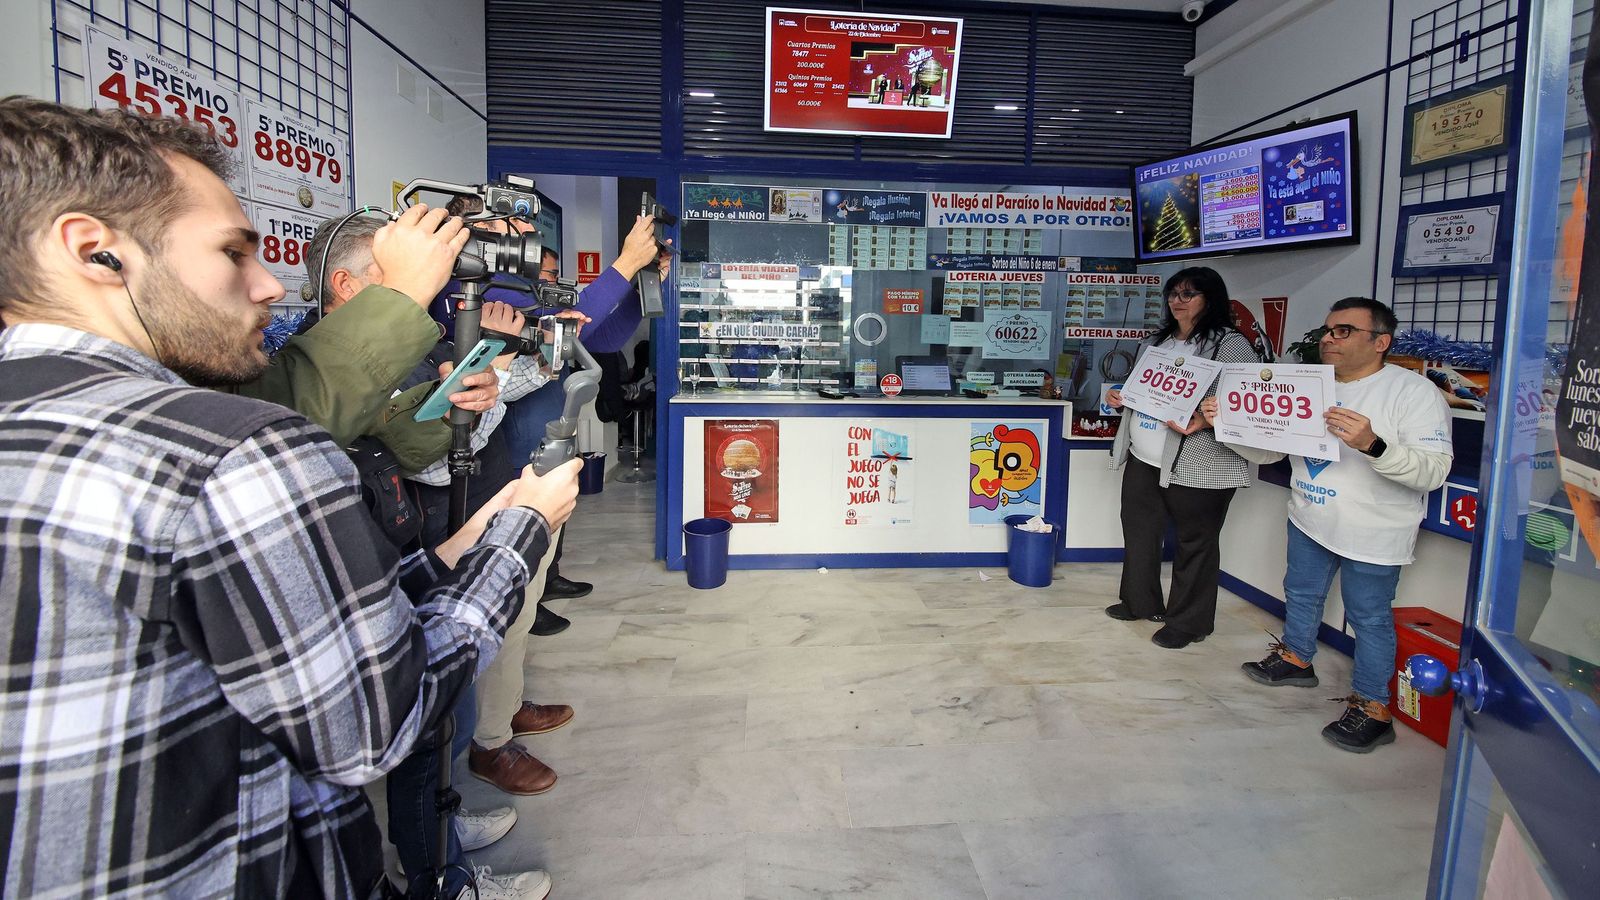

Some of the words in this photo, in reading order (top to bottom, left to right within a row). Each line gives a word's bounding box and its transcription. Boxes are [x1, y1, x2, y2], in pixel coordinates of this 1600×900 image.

[787, 40, 811, 48] Cuartos
[146, 53, 178, 72] VENDIDO
[180, 68, 197, 81] AQUÍ
[788, 73, 810, 81] Quintos
[810, 74, 833, 82] Premios
[134, 58, 229, 114] PREMIO
[99, 72, 239, 148] 45353
[1443, 100, 1472, 112] DIPLOMA
[1431, 109, 1483, 131] 19570
[1434, 126, 1462, 136] VENDIDO
[1463, 120, 1479, 129] AQUÍ
[275, 121, 335, 157] PREMIO
[254, 131, 341, 184] 88979
[1140, 163, 1180, 182] ¡FELIZ
[1184, 146, 1253, 170] NAVIDAD!
[1268, 184, 1278, 199] Ya
[1278, 183, 1294, 199] está
[1295, 175, 1311, 196] aquí
[1312, 172, 1320, 188] el
[1320, 168, 1341, 186] NIÑO
[862, 195, 886, 209] ¡Regala
[887, 193, 911, 205] ilusión!
[931, 193, 949, 209] Ya
[951, 193, 979, 212] llegó
[981, 196, 993, 210] al
[996, 195, 1040, 211] Paraíso
[1043, 196, 1054, 210] la
[1056, 196, 1107, 213] Navidad
[1109, 198, 1131, 213] 202
[685, 209, 700, 219] ¡Ya
[702, 209, 725, 221] llegó
[727, 210, 736, 219] el
[738, 209, 765, 220] NIÑO!
[869, 210, 894, 222] ¡Regala
[895, 208, 921, 221] lotería!
[939, 212, 1010, 226] ¡VAMOS
[1015, 214, 1028, 224] A
[1033, 214, 1070, 225] POR
[1075, 215, 1130, 227] OTRO!
[1436, 214, 1464, 222] DIPLOMA
[268, 218, 281, 235] 1er
[282, 221, 317, 240] PRE
[1423, 225, 1475, 238] 05490
[992, 256, 1010, 270] Sorteo
[1010, 257, 1018, 270] del
[1018, 257, 1030, 270] Niño
[1031, 257, 1035, 270] 6
[1035, 258, 1042, 270] de
[1042, 260, 1057, 270] enero
[949, 272, 998, 282] LOTERIA
[1000, 273, 1043, 282] JUEVES
[1069, 275, 1116, 284] LOTERIA
[1118, 276, 1160, 285] JUEVES
[715, 324, 734, 337] ¿EN
[752, 325, 784, 337] CIUDAD
[994, 326, 1038, 340] 60622
[1068, 328, 1113, 338] LOTERIA
[1116, 329, 1157, 339] SABAD
[1165, 365, 1194, 379] PREMIO
[1575, 358, 1600, 384] Sor
[885, 376, 898, 384] +18
[1139, 368, 1198, 399] 90693
[1251, 382, 1295, 394] PREMIO
[1228, 391, 1313, 420] 90693
[1139, 421, 1157, 431] AQUÍ
[1246, 416, 1273, 425] VENDIDO
[1274, 418, 1290, 427] AQUÍ
[848, 426, 871, 441] CON
[848, 442, 860, 456] EL
[848, 459, 882, 473] JUEGO
[847, 475, 864, 489] NO
[868, 475, 880, 488] SE
[1296, 479, 1336, 497] VENDIDO
[847, 489, 880, 505] JUEGA
[1303, 492, 1325, 504] AQUÍ
